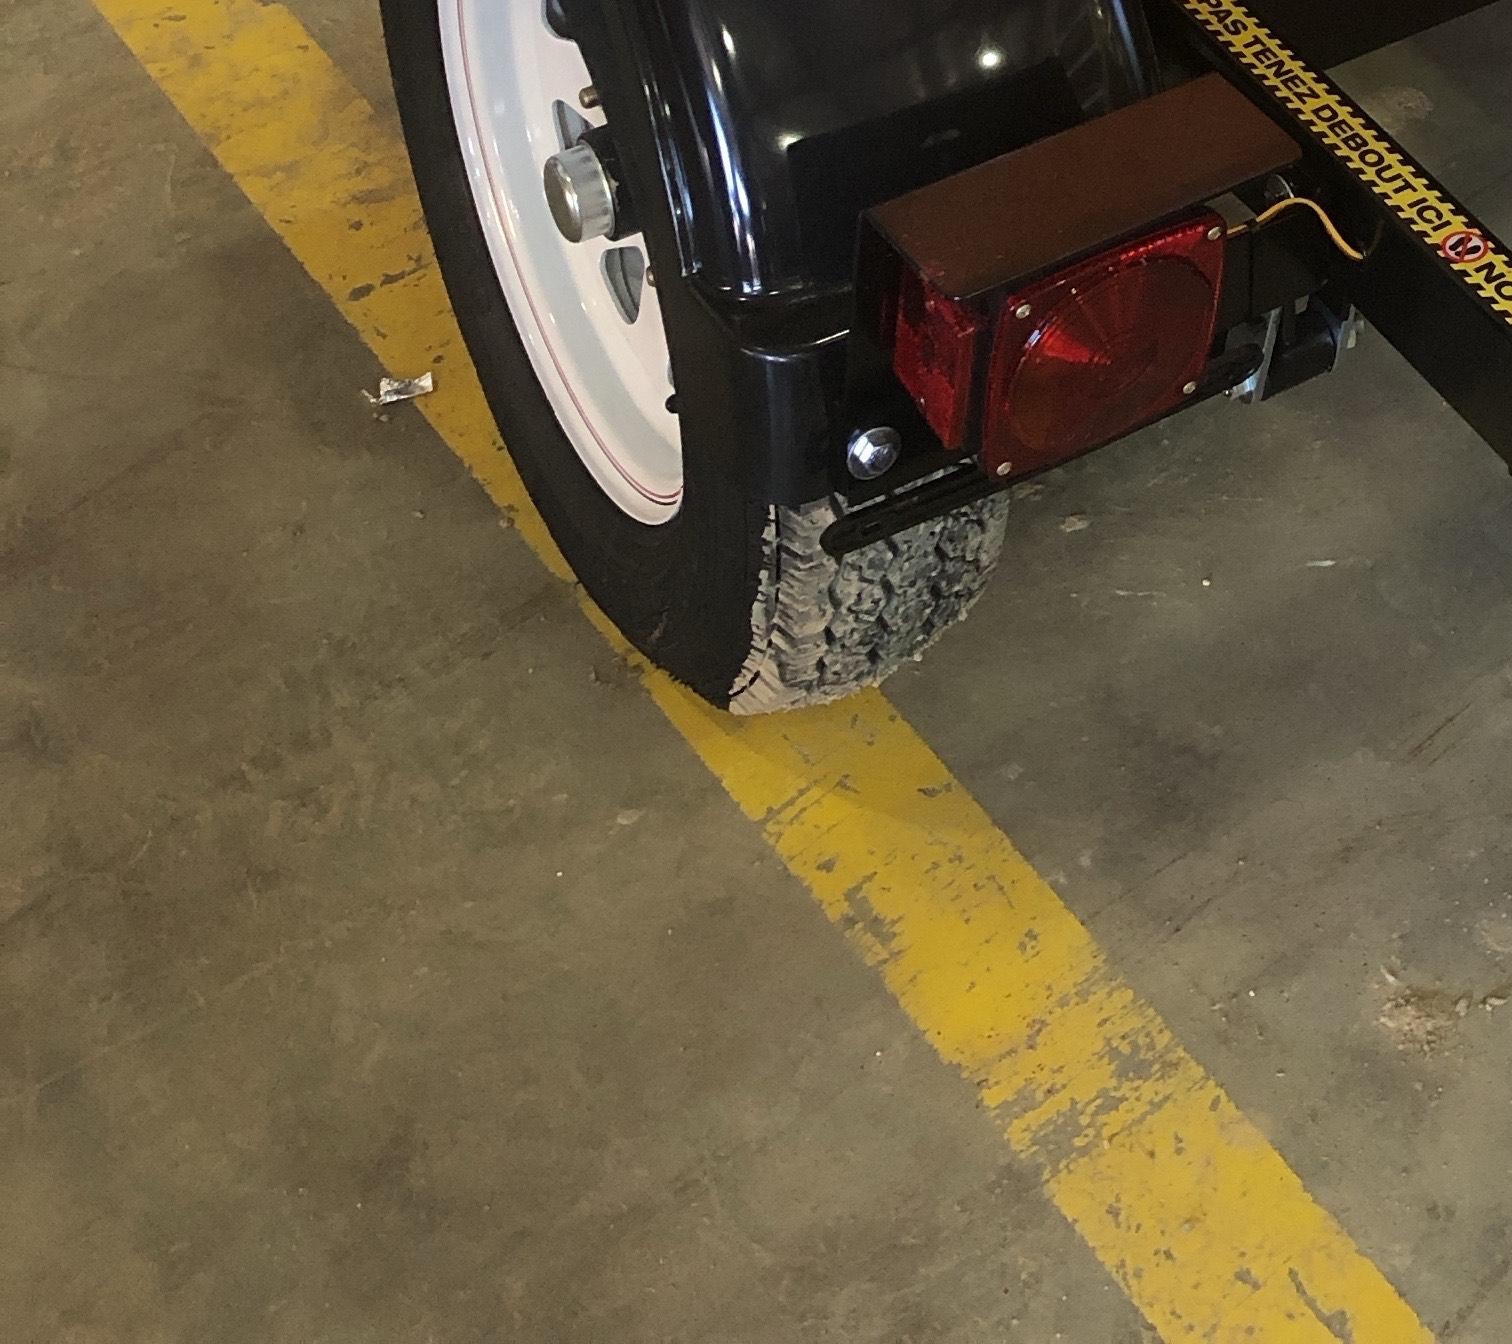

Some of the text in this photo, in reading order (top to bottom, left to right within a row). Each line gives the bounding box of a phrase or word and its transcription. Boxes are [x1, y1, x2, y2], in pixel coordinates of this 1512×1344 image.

[1242, 34, 1321, 106] TENEZ
[1310, 103, 1418, 202] DEBOUT
[1410, 197, 1452, 234] ICI
